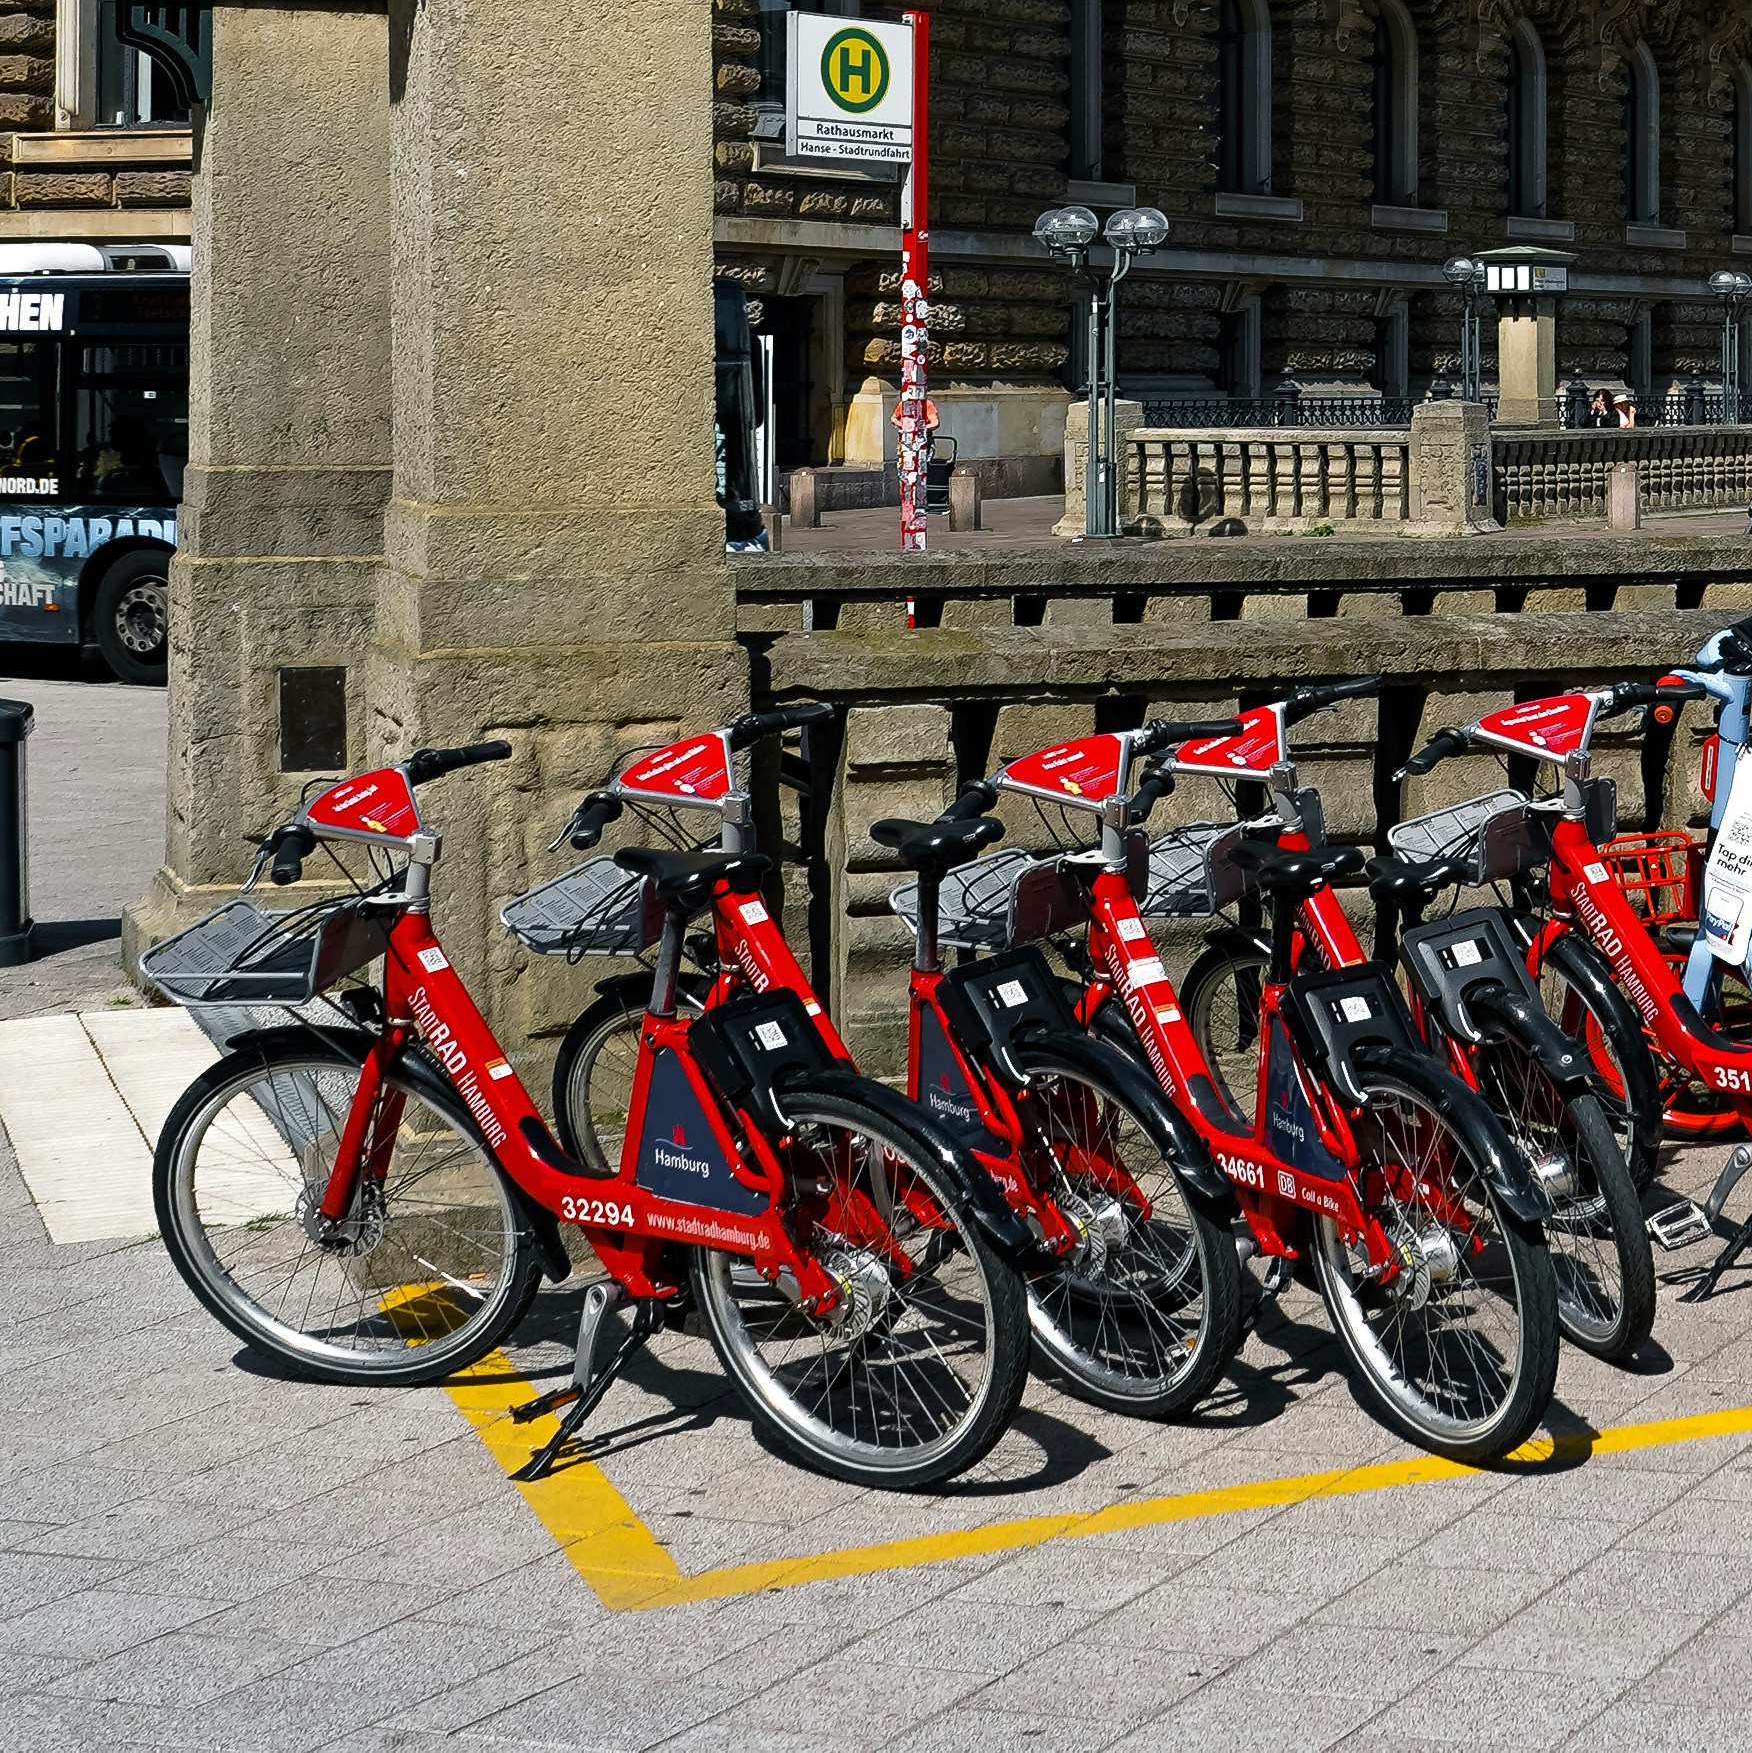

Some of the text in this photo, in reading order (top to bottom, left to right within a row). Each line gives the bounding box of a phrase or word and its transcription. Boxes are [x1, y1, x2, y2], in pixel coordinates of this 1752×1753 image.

[840, 46, 871, 95] H
[816, 123, 894, 141] Rathausmarkt
[800, 141, 832, 154] Hanse
[838, 143, 910, 160] Stadtrundfahrt
[1719, 842, 1738, 863] Tap
[1716, 857, 1747, 877] mehr
[1706, 912, 1732, 932] PayPal
[929, 1092, 971, 1123] Hamburg
[1273, 1111, 1305, 1142] Hamburg
[654, 1148, 710, 1179] Hamburg
[1301, 1187, 1316, 1203] Call
[1316, 1195, 1322, 1205] a
[1323, 1195, 1340, 1212] Bike
[561, 1195, 771, 1251] 32294 www.stadtradhamburg.de
